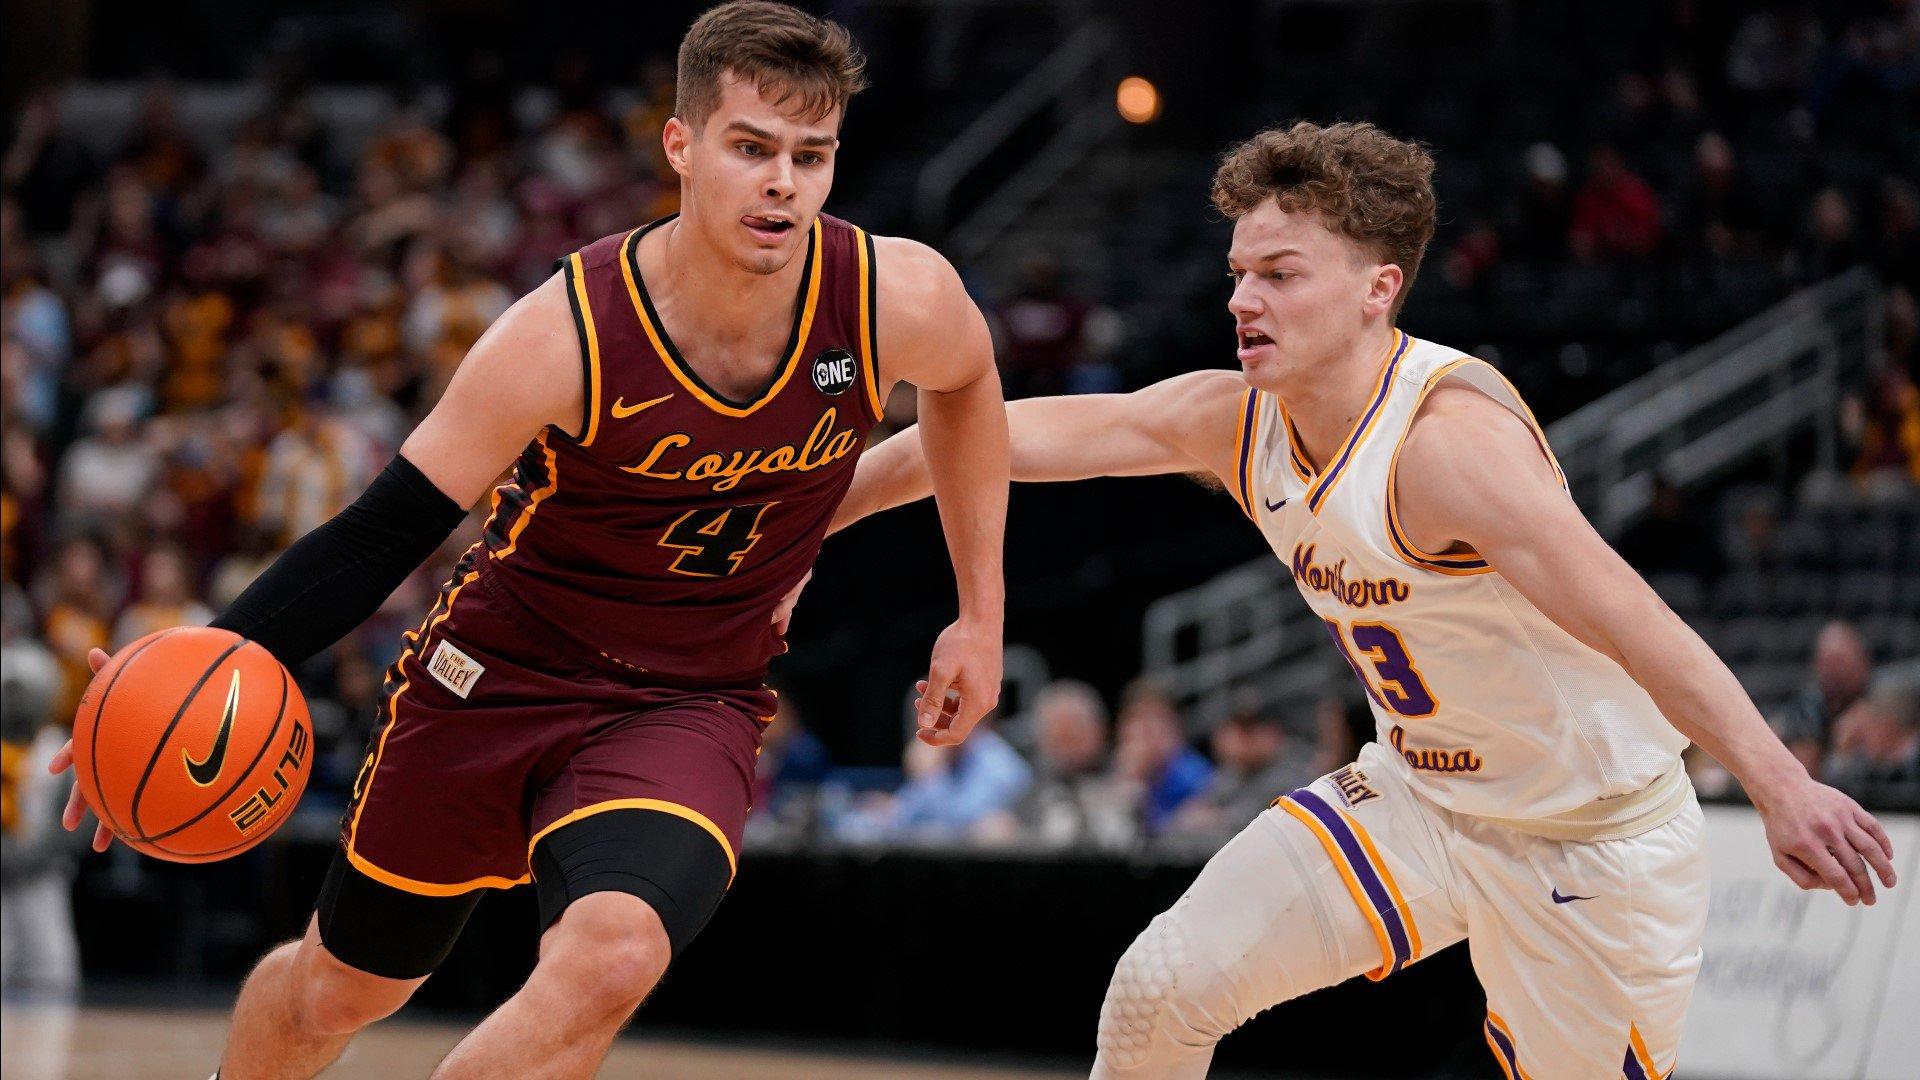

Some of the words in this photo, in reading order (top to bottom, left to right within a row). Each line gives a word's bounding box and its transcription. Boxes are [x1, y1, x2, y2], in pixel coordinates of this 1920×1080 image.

[816, 357, 853, 387] ONE
[618, 407, 858, 492] Loyola
[657, 501, 782, 577] 4
[1292, 542, 1411, 608] Northern
[432, 648, 479, 690] VALLEY
[1324, 614, 1440, 720] 13
[228, 718, 309, 833] ELITE
[1390, 724, 1484, 774] Iowa
